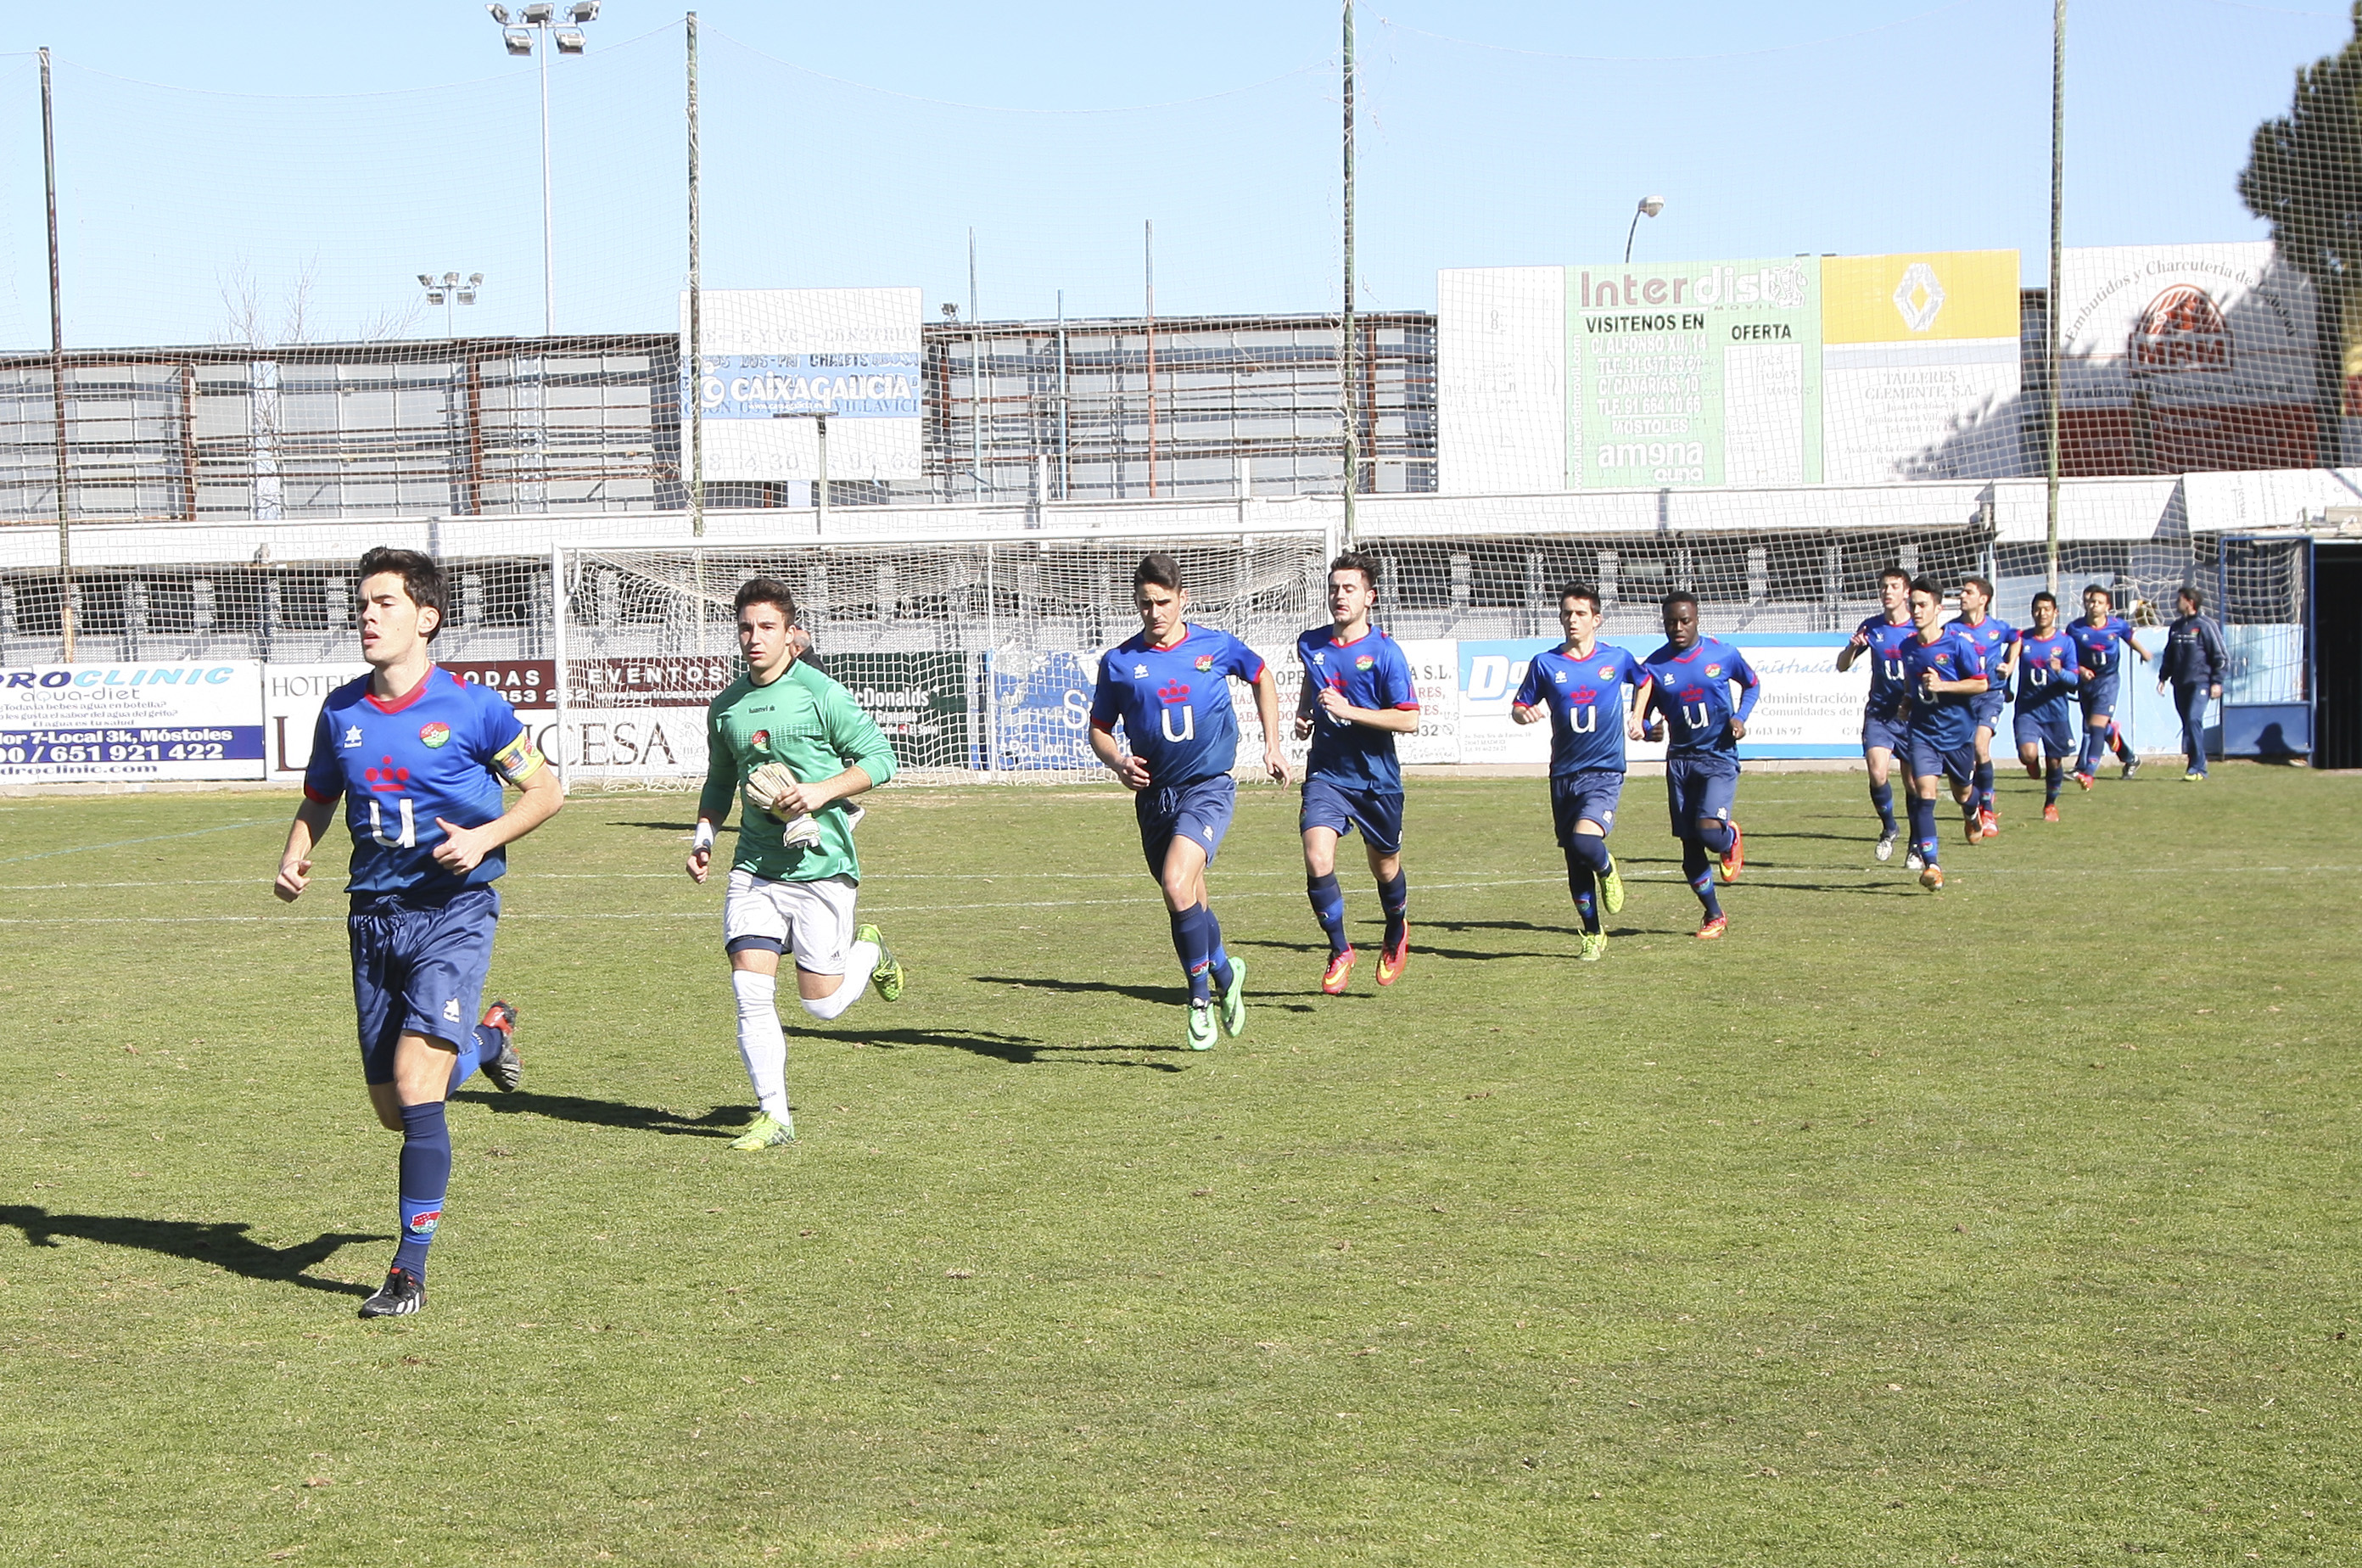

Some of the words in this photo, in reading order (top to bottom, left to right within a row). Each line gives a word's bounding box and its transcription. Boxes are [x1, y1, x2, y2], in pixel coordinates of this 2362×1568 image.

[2064, 273, 2131, 343] Embutidos
[1585, 314, 1677, 333] VISITENOS
[1682, 313, 1704, 331] EN
[1731, 324, 1793, 341] OFERTA
[1606, 334, 1665, 353] ALFONSO
[1692, 333, 1708, 351] 14
[1613, 376, 1682, 398] CANARIAS,
[1883, 370, 1957, 385] TALLERES
[730, 370, 913, 409] CAIXAGALICIA
[1597, 398, 1621, 415] TLF.
[1624, 397, 1639, 414] 91
[1643, 396, 1665, 413] 664
[1597, 440, 1704, 467] amena
[588, 666, 724, 685] EVENTOS
[1423, 664, 1452, 680] S.L.
[875, 709, 918, 723] Granada
[1761, 707, 1836, 717] Comunidades
[1839, 706, 1853, 716] de
[105, 730, 138, 745] 3k,
[140, 729, 233, 742] Móstoles
[49, 745, 102, 763] 651
[109, 744, 160, 761] 921
[168, 743, 225, 760] 422
